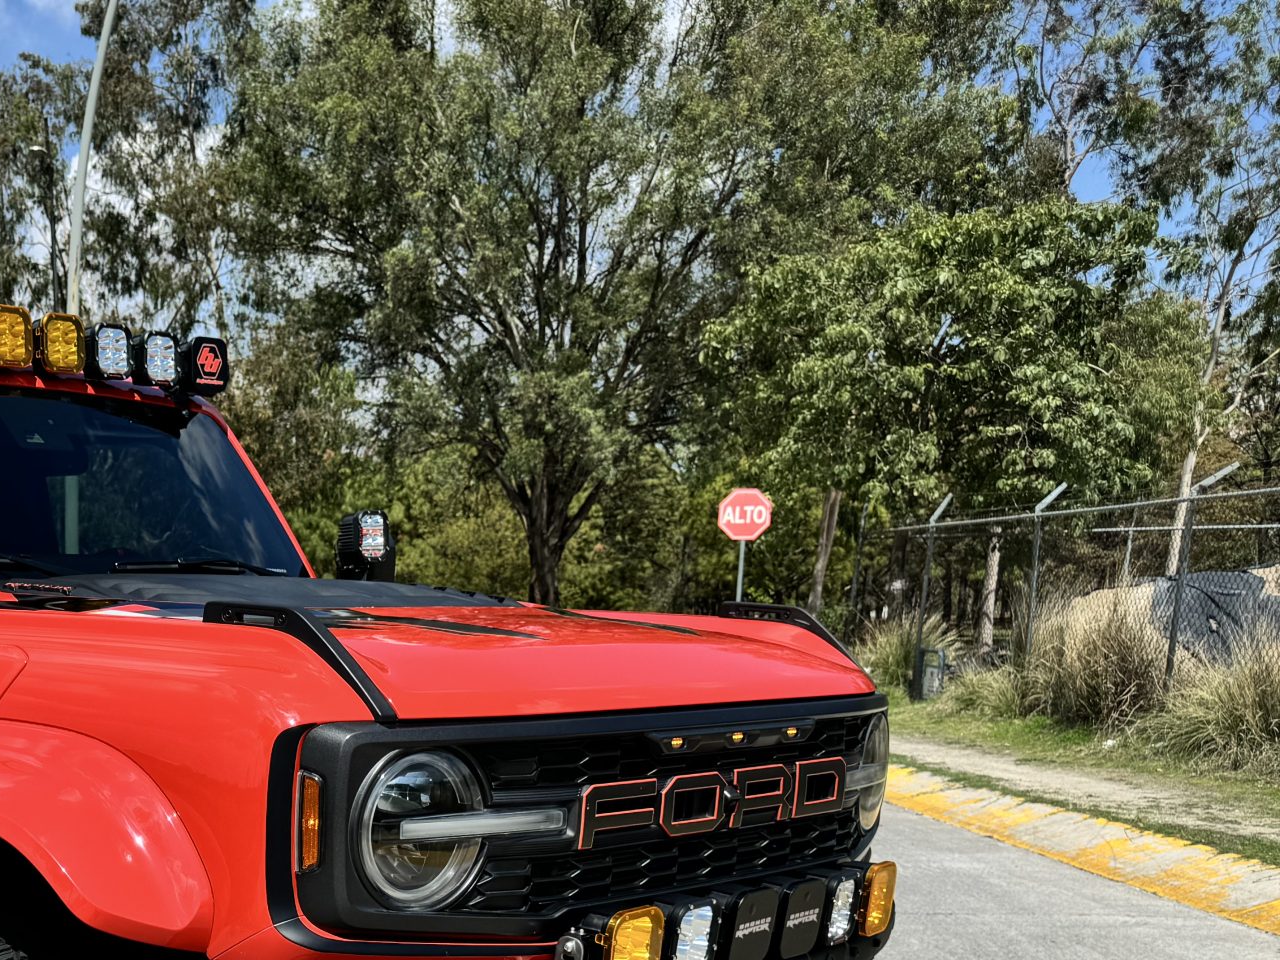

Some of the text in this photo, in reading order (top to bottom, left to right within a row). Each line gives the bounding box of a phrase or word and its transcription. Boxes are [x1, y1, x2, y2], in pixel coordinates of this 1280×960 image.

[722, 505, 767, 524] ALTO
[579, 757, 847, 849] FORD
[787, 914, 818, 928] RAPTOR
[735, 923, 770, 938] RAPTOR
